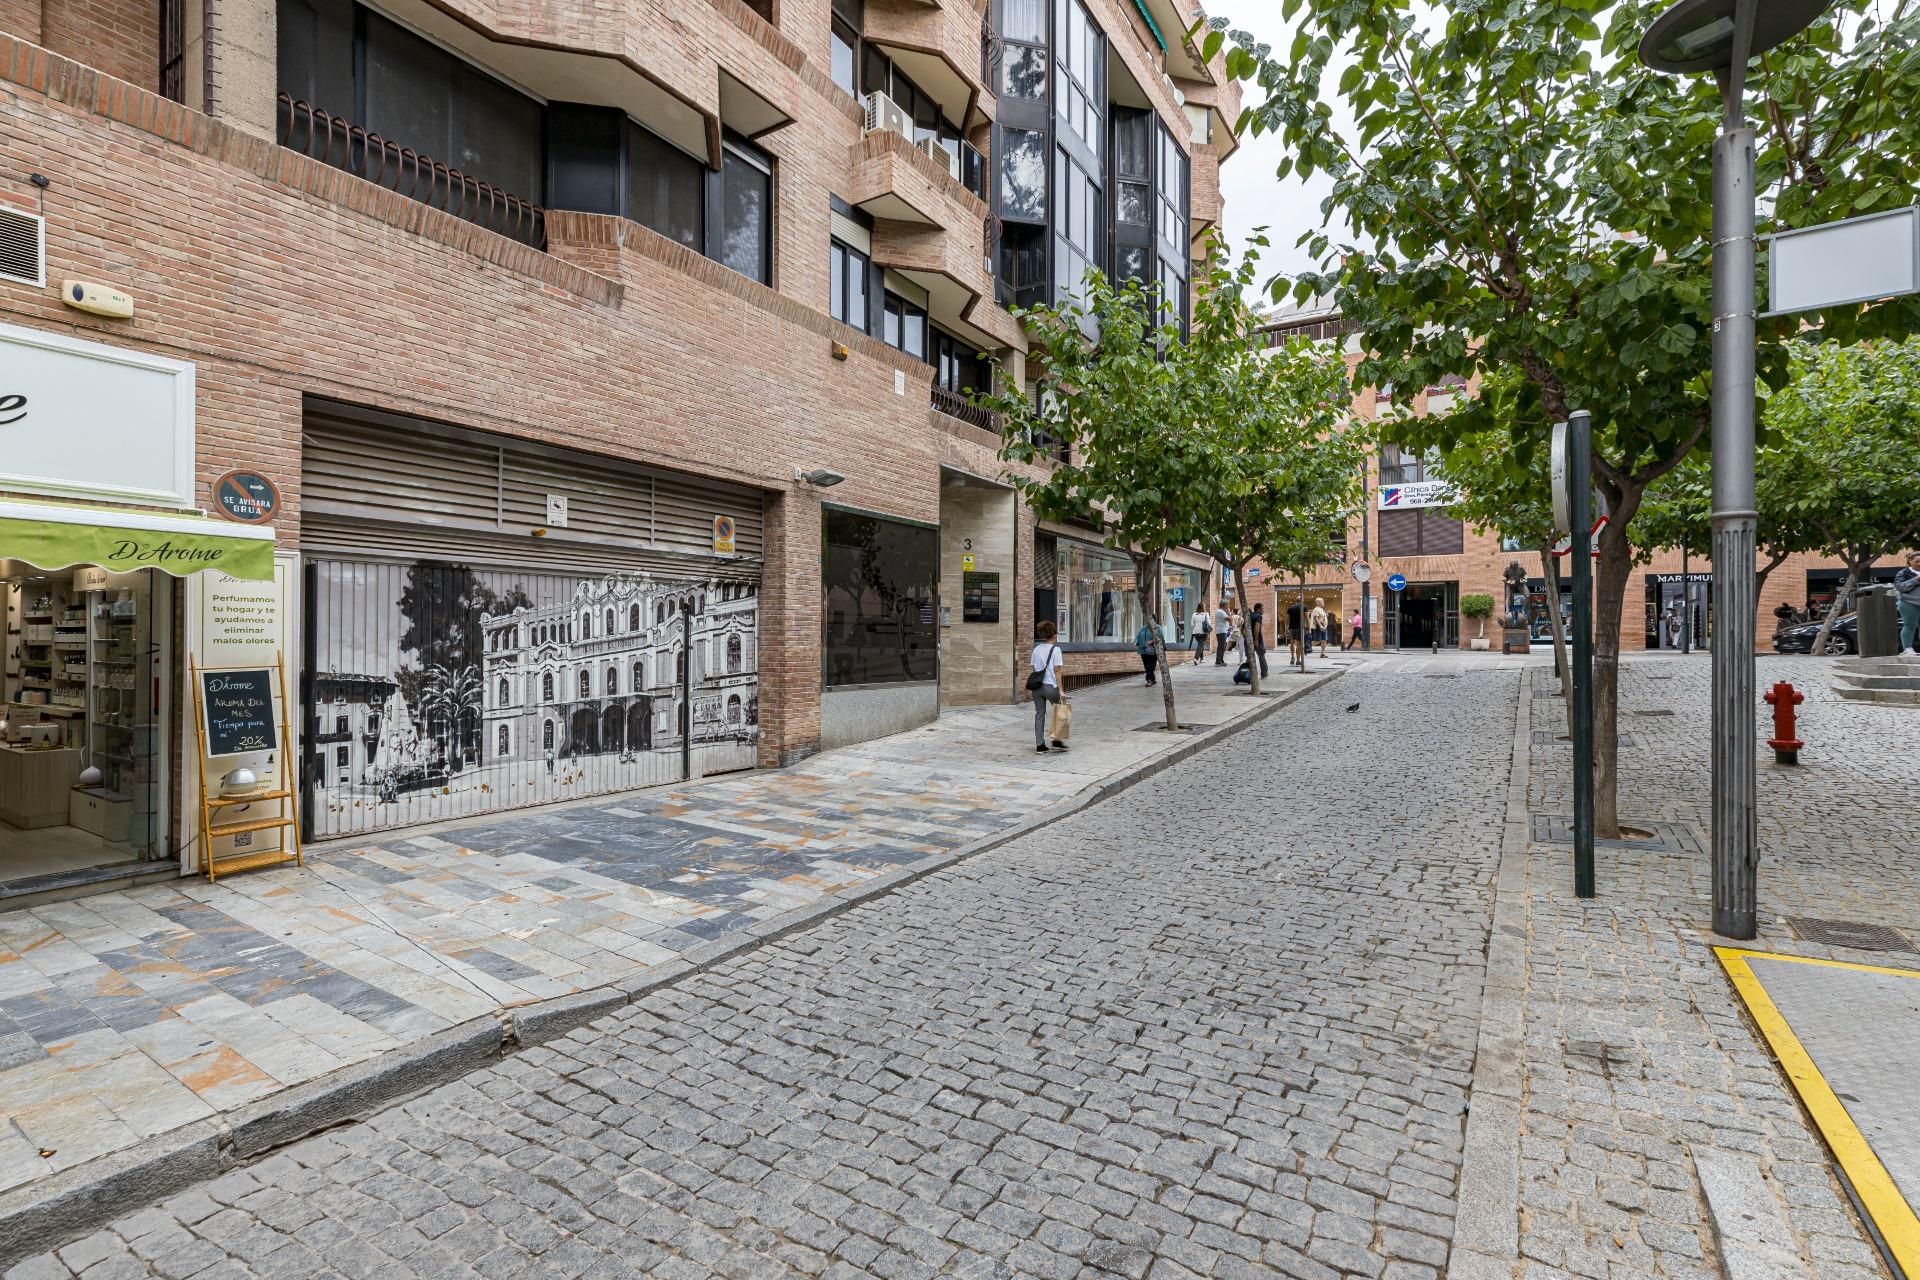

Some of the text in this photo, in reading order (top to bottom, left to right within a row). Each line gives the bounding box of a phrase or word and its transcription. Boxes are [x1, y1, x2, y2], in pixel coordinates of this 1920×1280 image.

[224, 496, 271, 508] SE AVISARA
[233, 504, 261, 515] GRUA
[964, 538, 972, 550] 3
[212, 594, 276, 603] Perfumamos
[226, 605, 255, 614] hogar
[214, 616, 265, 624] ayudamos
[224, 626, 264, 634] eliminar
[215, 698, 265, 708] AROMA DEL
[231, 710, 252, 718] MES
[239, 736, 264, 746] 20%
